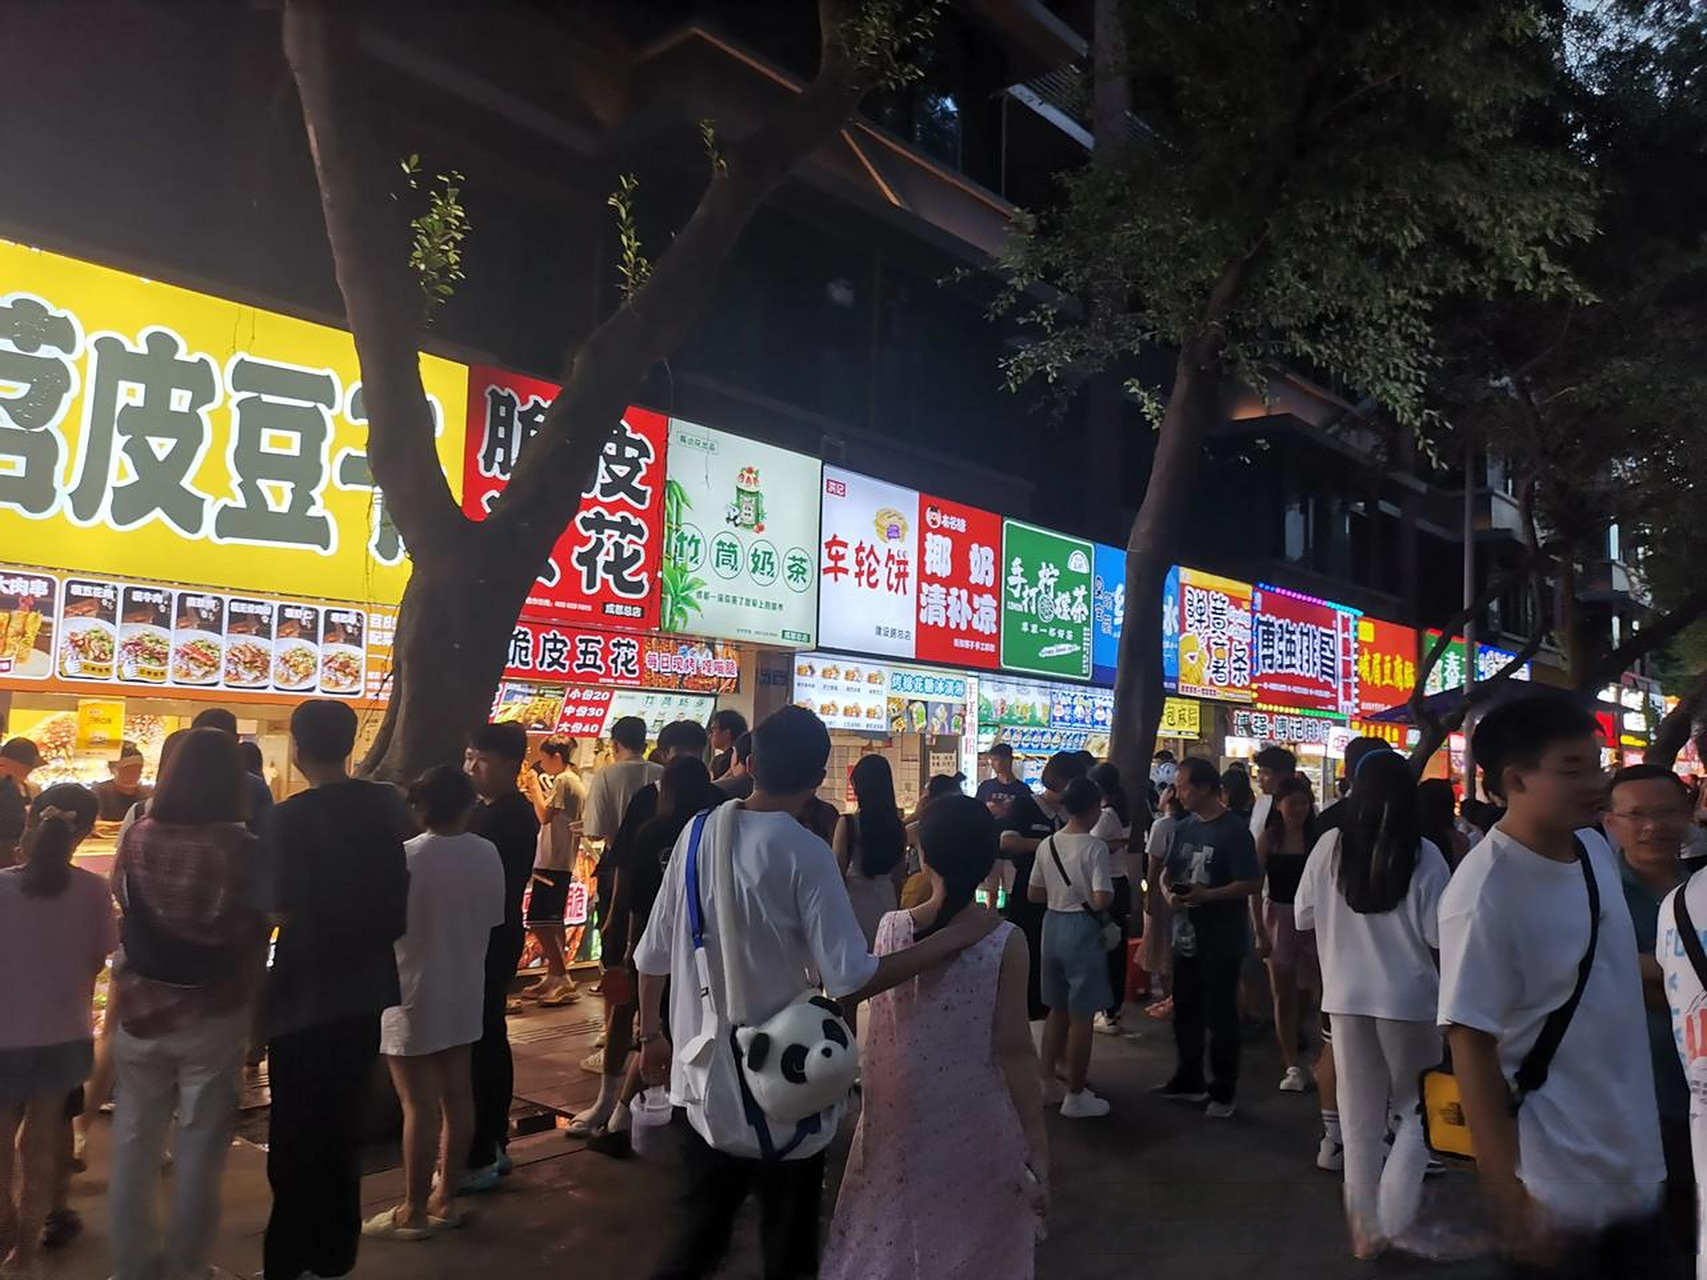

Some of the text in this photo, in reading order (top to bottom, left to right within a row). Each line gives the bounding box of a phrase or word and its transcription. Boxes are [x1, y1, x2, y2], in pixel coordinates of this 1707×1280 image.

[673, 529, 809, 585] 竹筒奶茶
[822, 533, 910, 596] 车轮饼
[919, 581, 997, 636] 清补凉
[1006, 556, 1090, 624] 手打柠檬茶
[508, 626, 640, 678] 脆皮五花
[563, 705, 605, 717] 中份30
[568, 688, 610, 703] 小份20
[557, 722, 600, 735] 大份40
